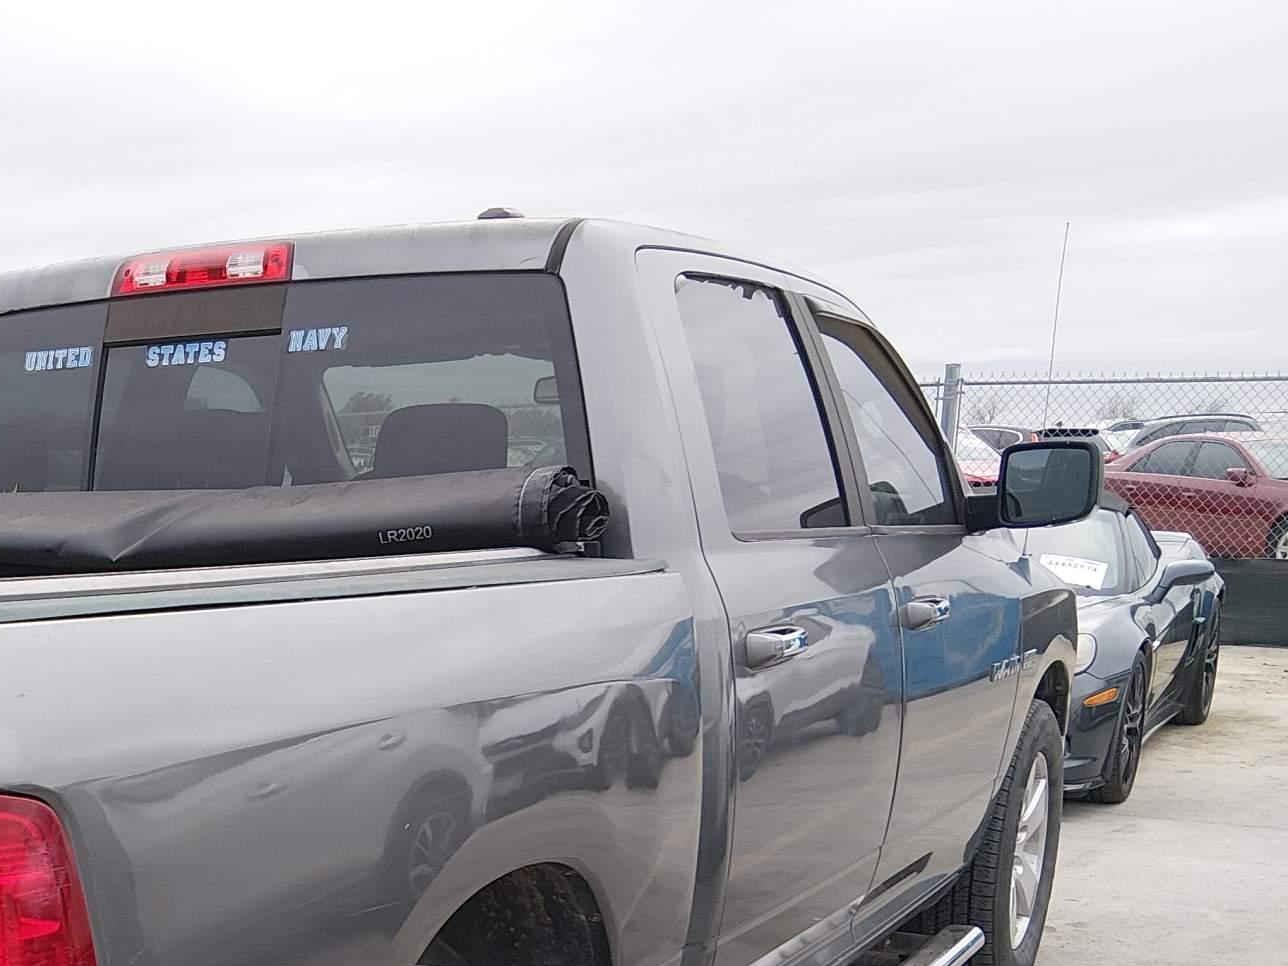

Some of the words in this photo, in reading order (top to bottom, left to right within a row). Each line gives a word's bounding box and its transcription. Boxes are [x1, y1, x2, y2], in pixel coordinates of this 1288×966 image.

[24, 346, 93, 372] UNITED
[146, 341, 226, 367] STATES
[288, 327, 347, 352] NAVY
[378, 525, 432, 544] LR2020
